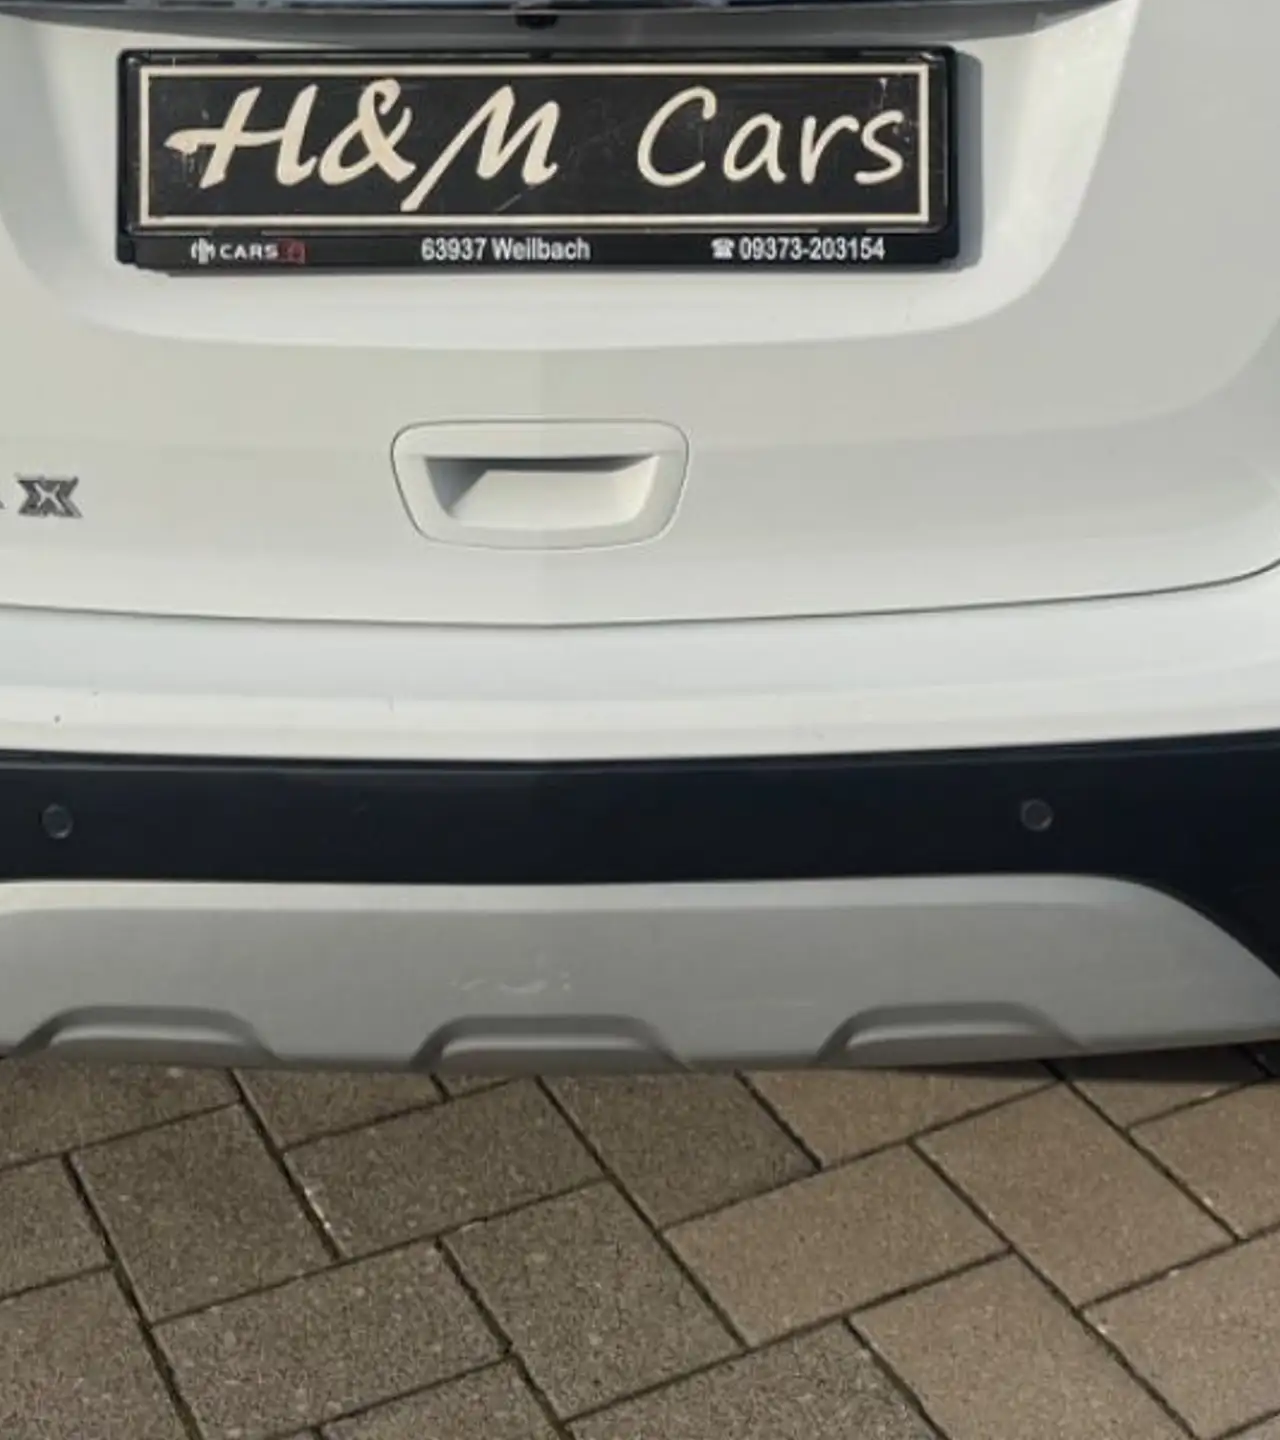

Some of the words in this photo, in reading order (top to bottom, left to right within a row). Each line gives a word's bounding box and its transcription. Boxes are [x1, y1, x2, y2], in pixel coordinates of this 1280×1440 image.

[165, 78, 560, 211] H&M
[636, 86, 906, 188] Cars
[420, 238, 486, 262] 63937
[491, 237, 591, 262] Weilbach
[738, 236, 886, 261] 09373-203154
